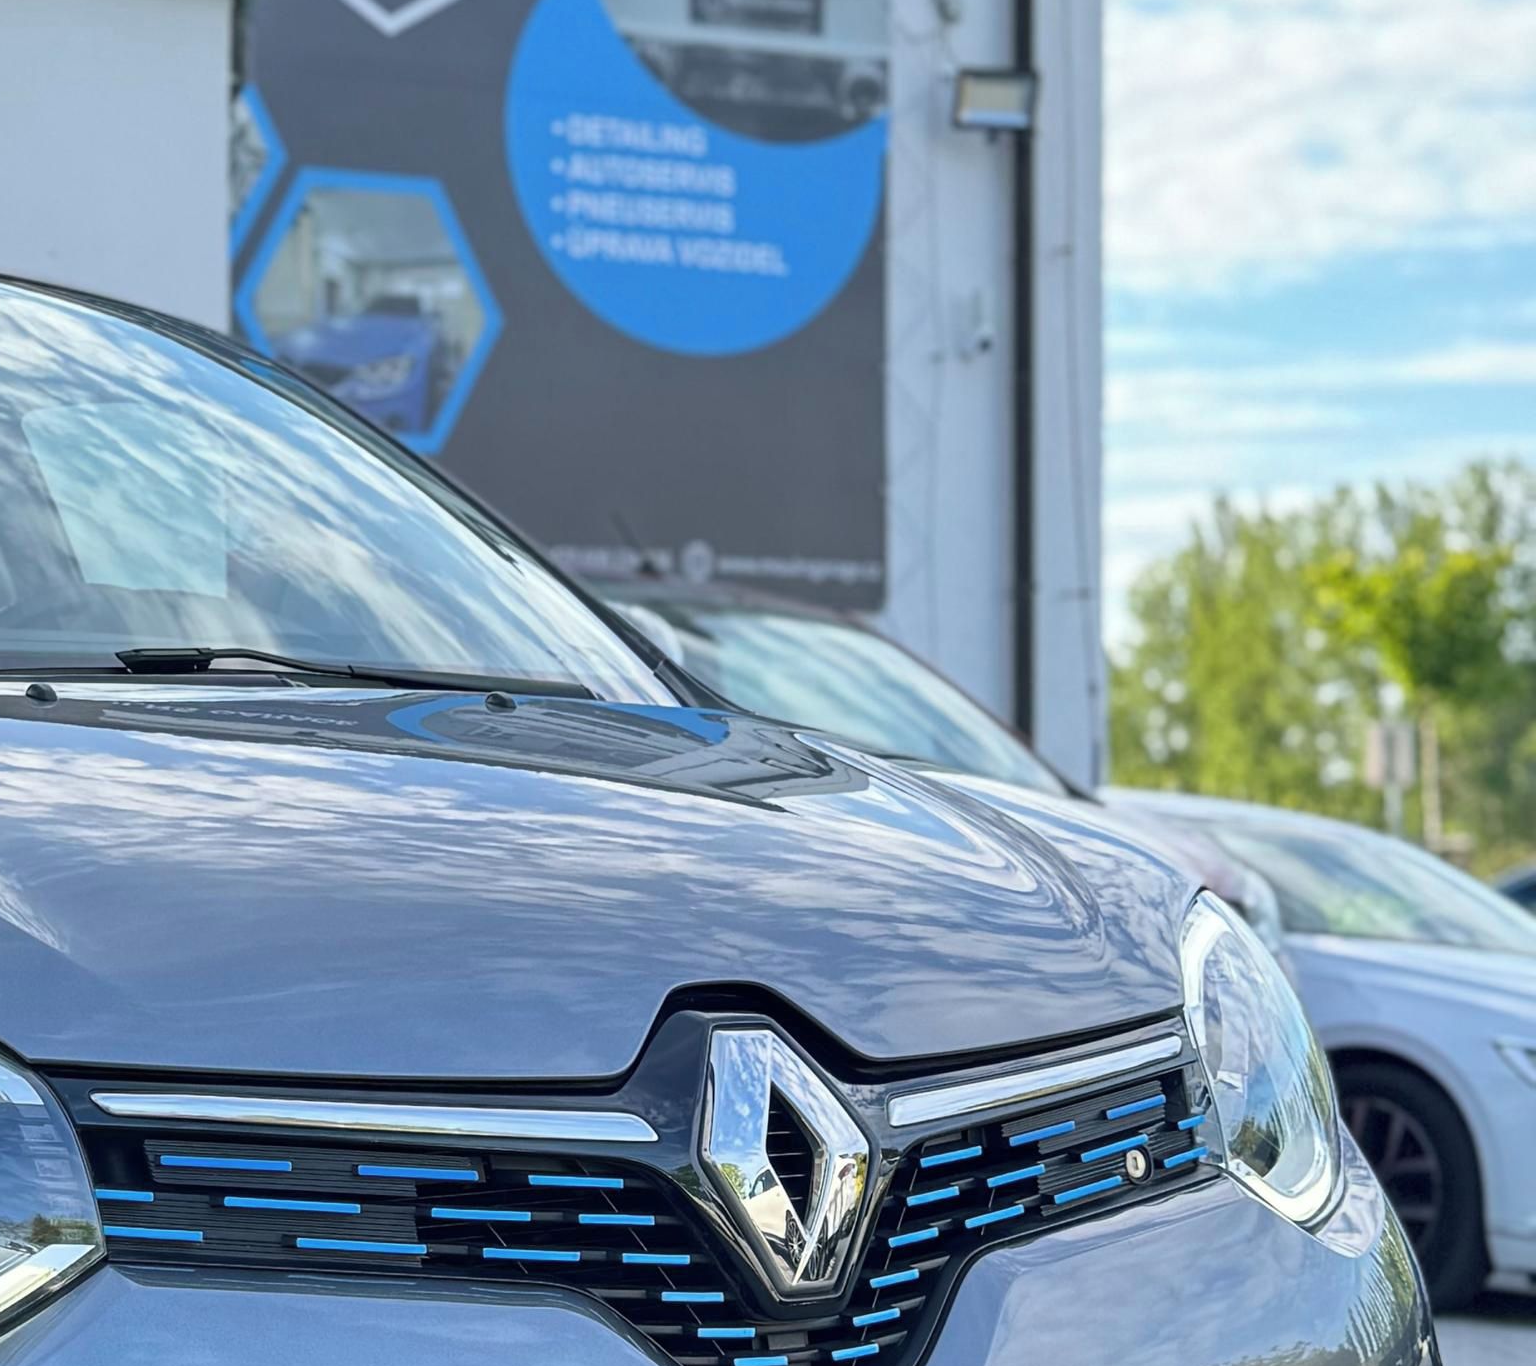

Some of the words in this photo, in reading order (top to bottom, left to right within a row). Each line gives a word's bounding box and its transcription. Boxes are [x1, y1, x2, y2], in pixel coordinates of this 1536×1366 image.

[567, 112, 709, 159] DETAILING
[567, 151, 736, 198] AUTOSERVIS
[565, 188, 736, 236] PNEUSERVIS
